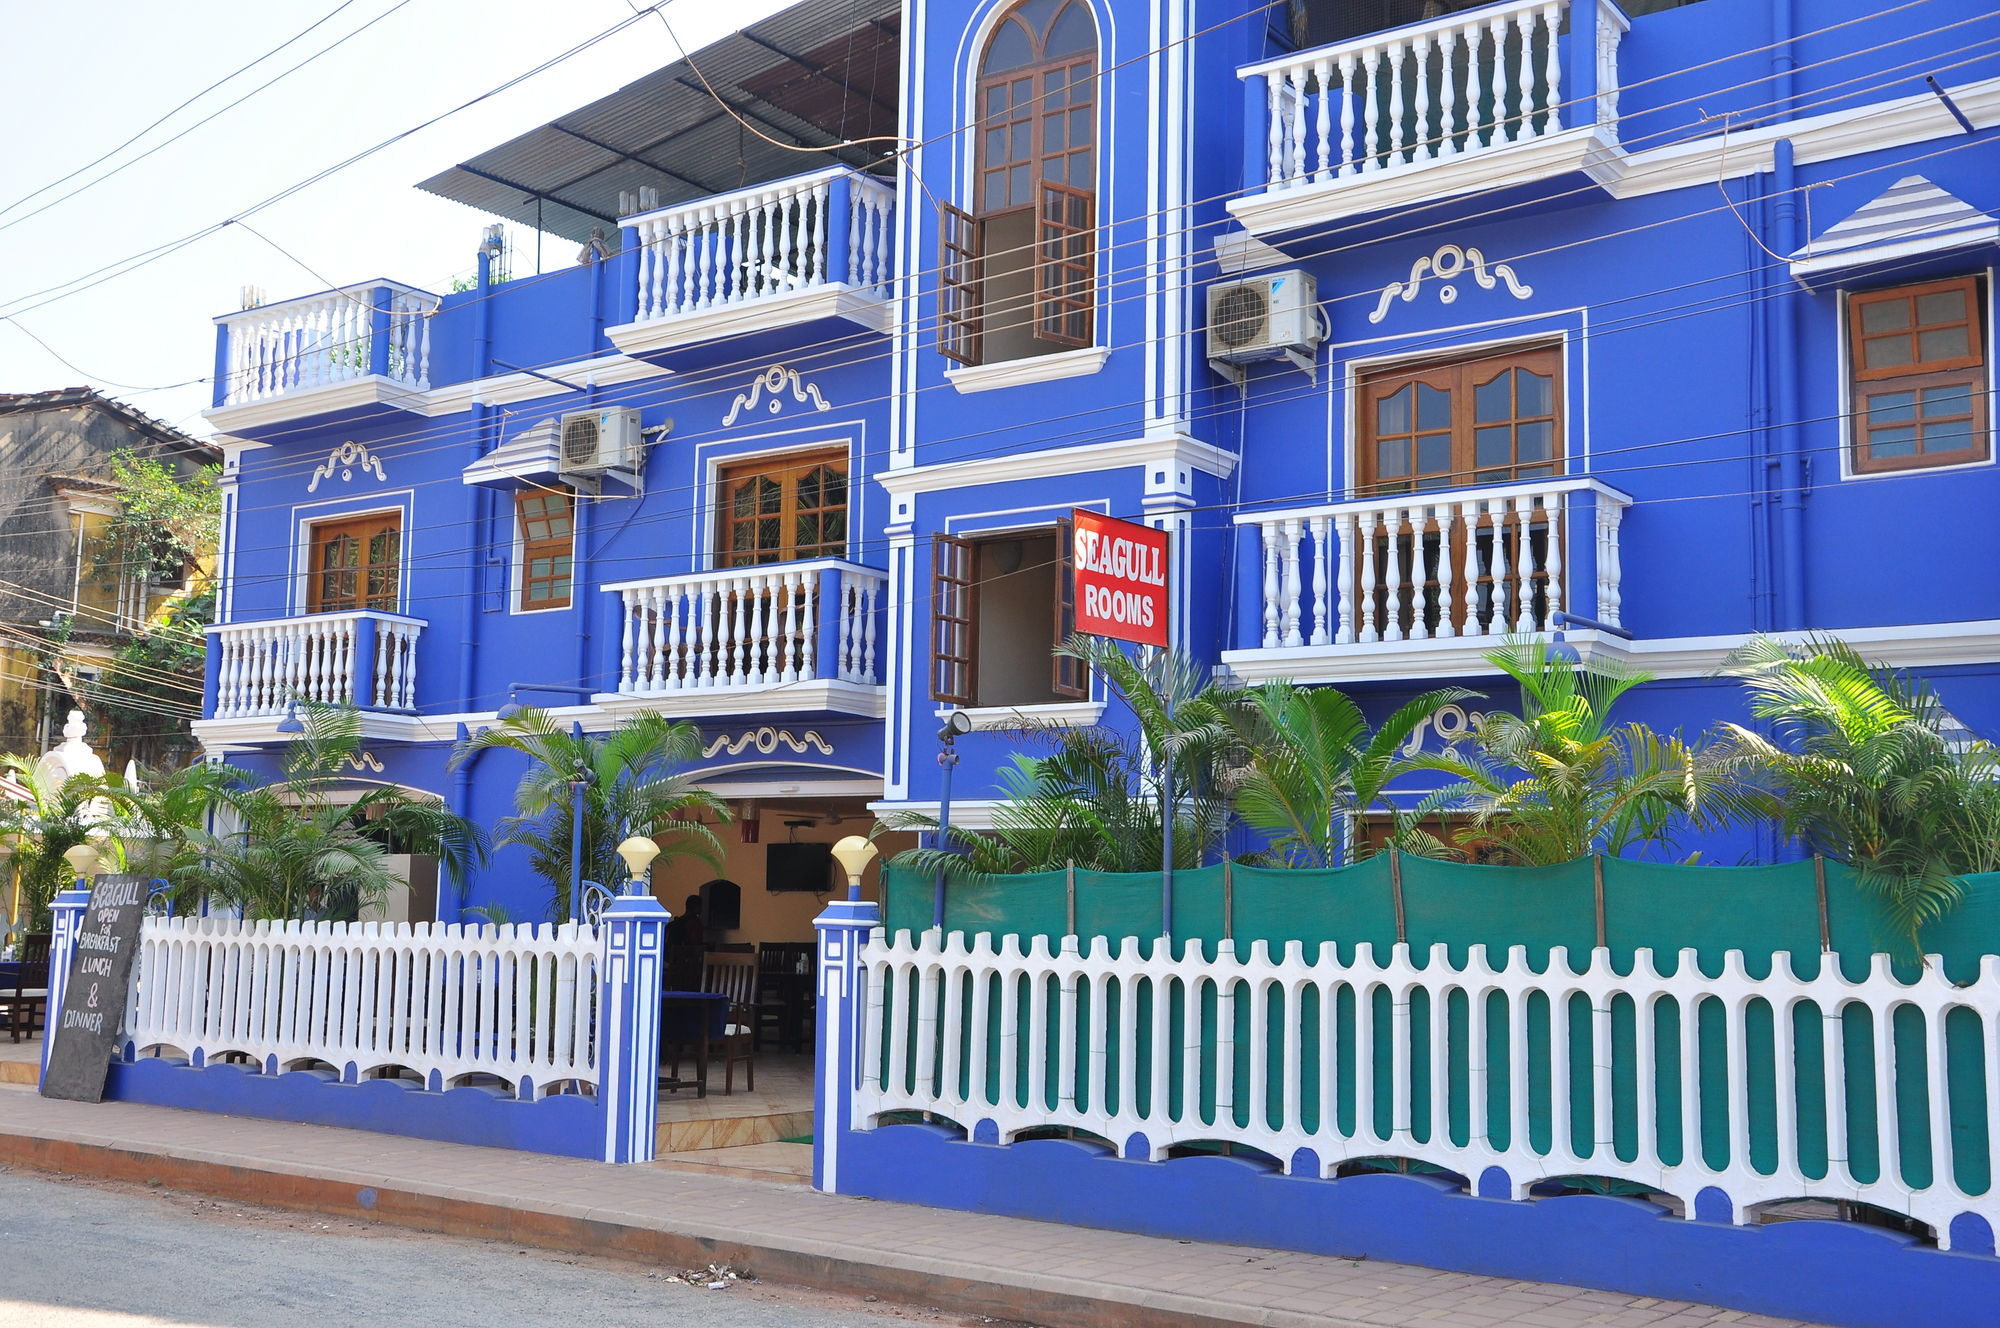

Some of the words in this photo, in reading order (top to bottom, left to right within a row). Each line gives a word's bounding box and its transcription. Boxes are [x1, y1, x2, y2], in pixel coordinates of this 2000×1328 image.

[1075, 528, 1164, 587] SEAGULL
[1085, 584, 1154, 628] ROOMS
[97, 908, 120, 923] OPEN
[79, 932, 121, 954] BREAKFAST
[81, 956, 113, 978] LUNCH
[87, 982, 98, 1008] &
[63, 1009, 103, 1036] DINNER
